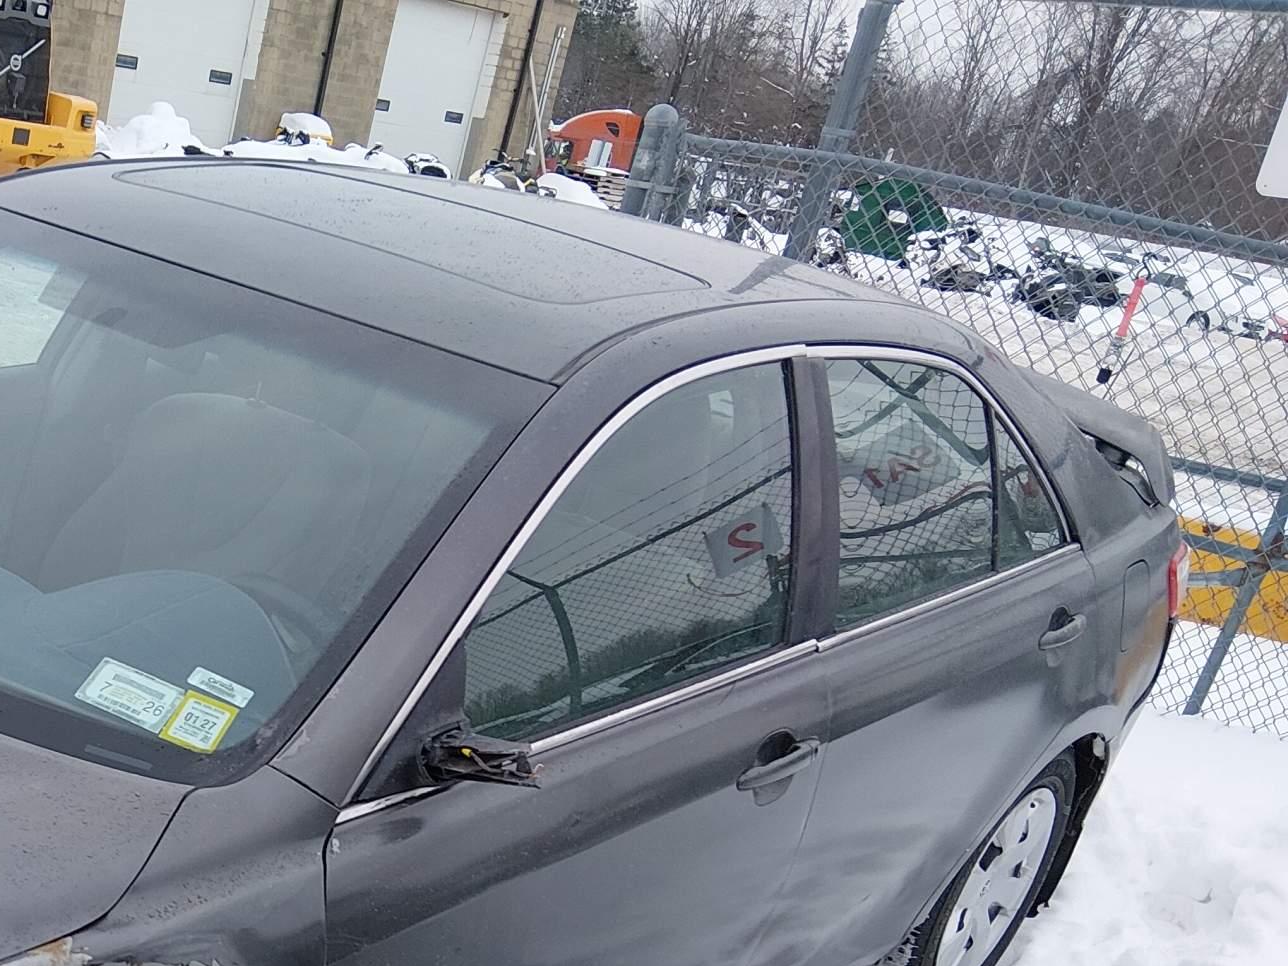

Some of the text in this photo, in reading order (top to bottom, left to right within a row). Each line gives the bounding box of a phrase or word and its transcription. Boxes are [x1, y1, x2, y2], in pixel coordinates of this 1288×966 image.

[142, 701, 165, 717] 26
[184, 712, 200, 725] 01
[200, 718, 217, 731] 27
